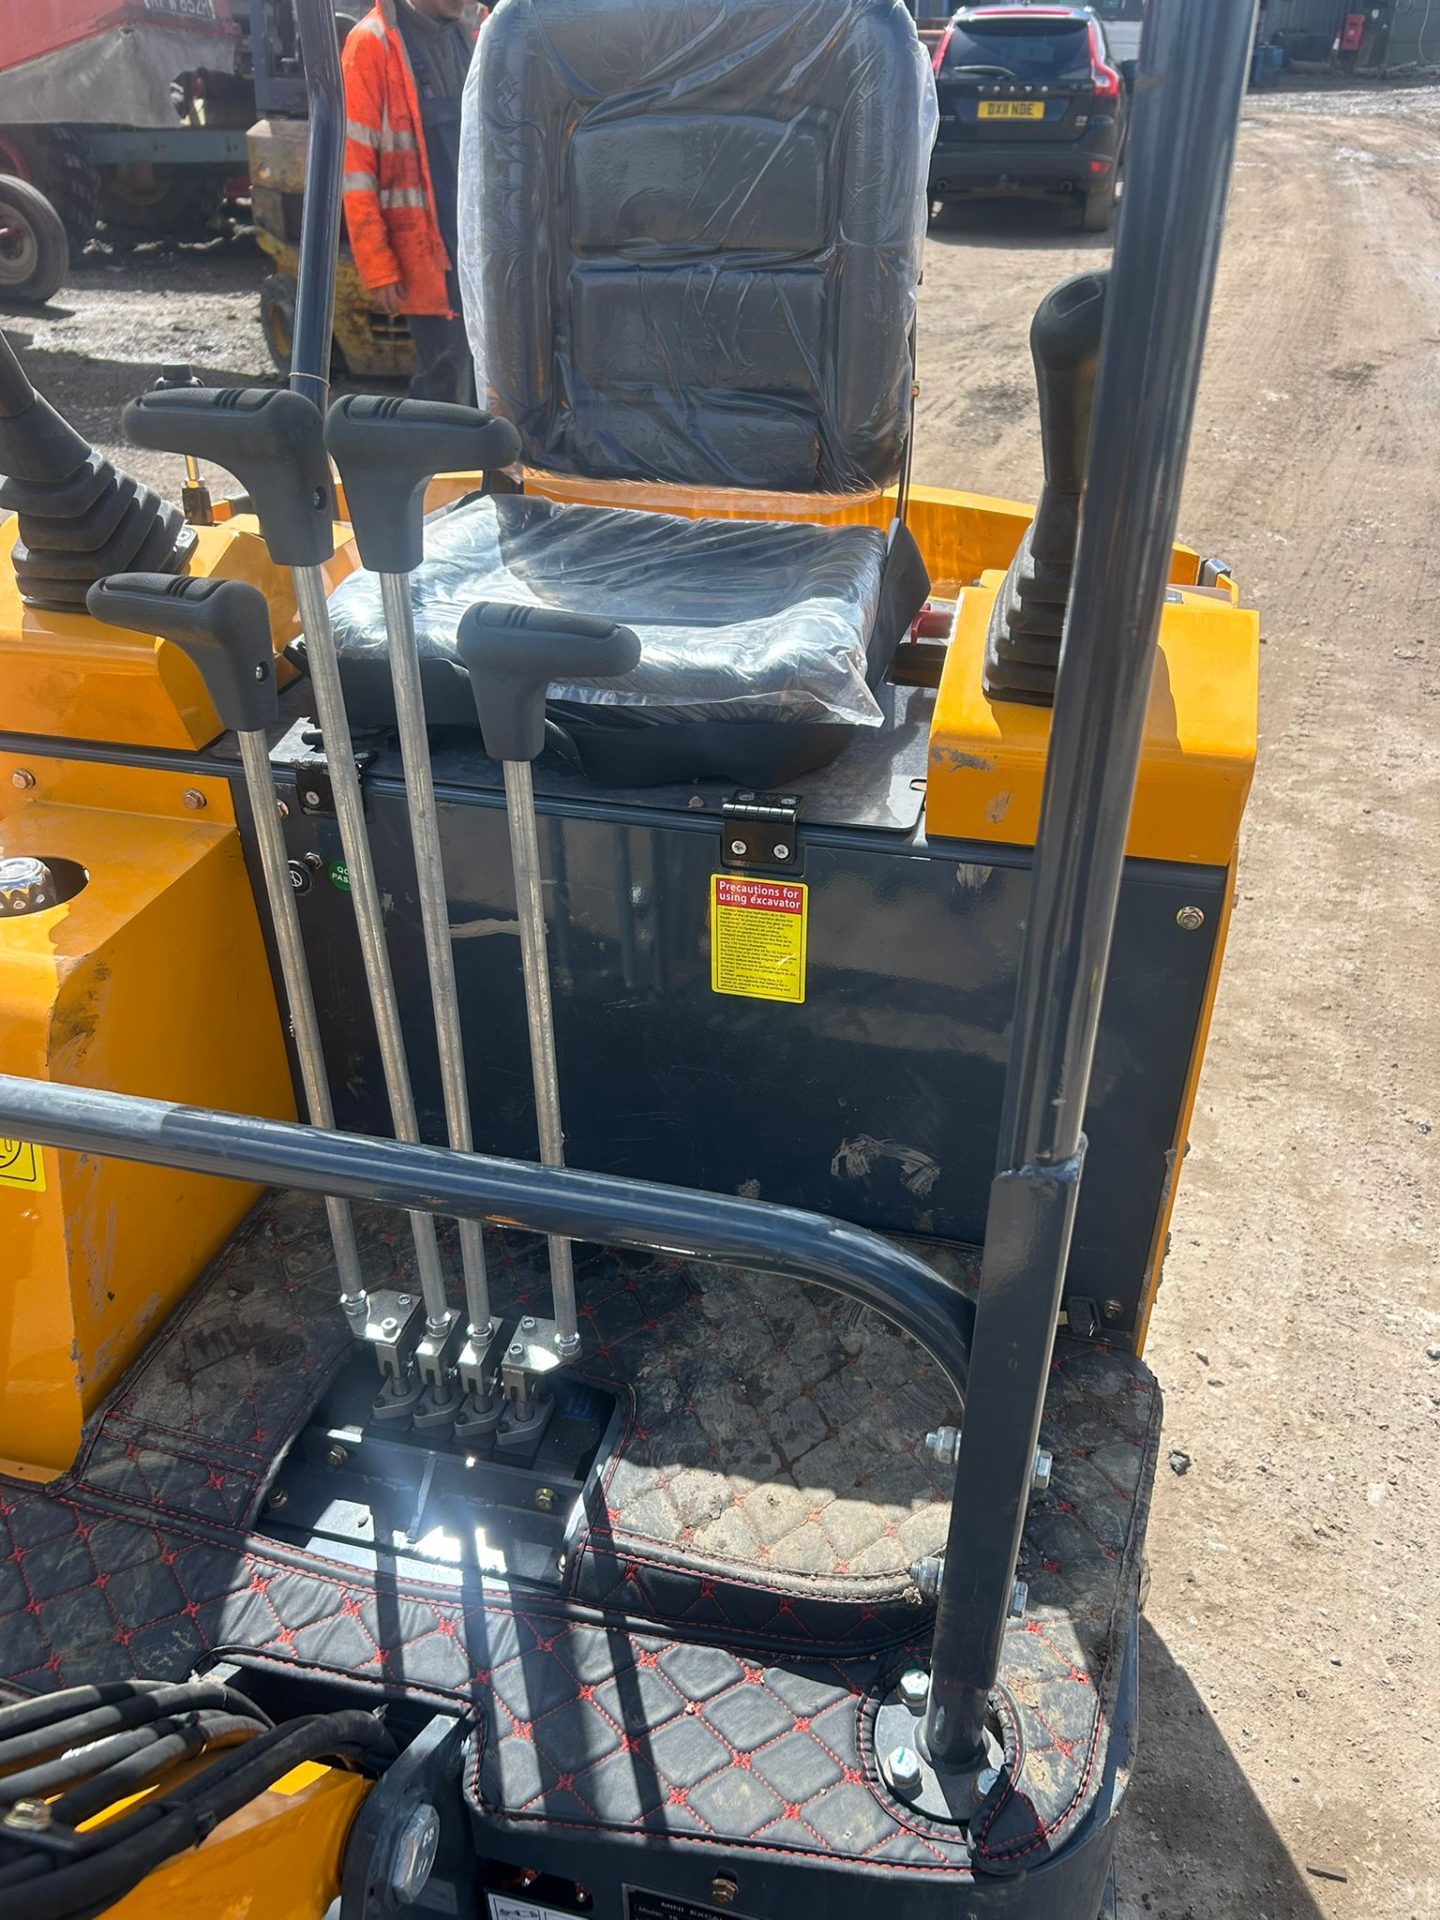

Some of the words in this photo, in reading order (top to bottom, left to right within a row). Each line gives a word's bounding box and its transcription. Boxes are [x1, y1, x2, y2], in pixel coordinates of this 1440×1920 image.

[331, 872, 350, 884] PAS
[719, 881, 780, 897] Precautions
[783, 888, 799, 899] for
[719, 892, 747, 905] using
[750, 896, 801, 909] excavator
[661, 1901, 684, 1913] MINI
